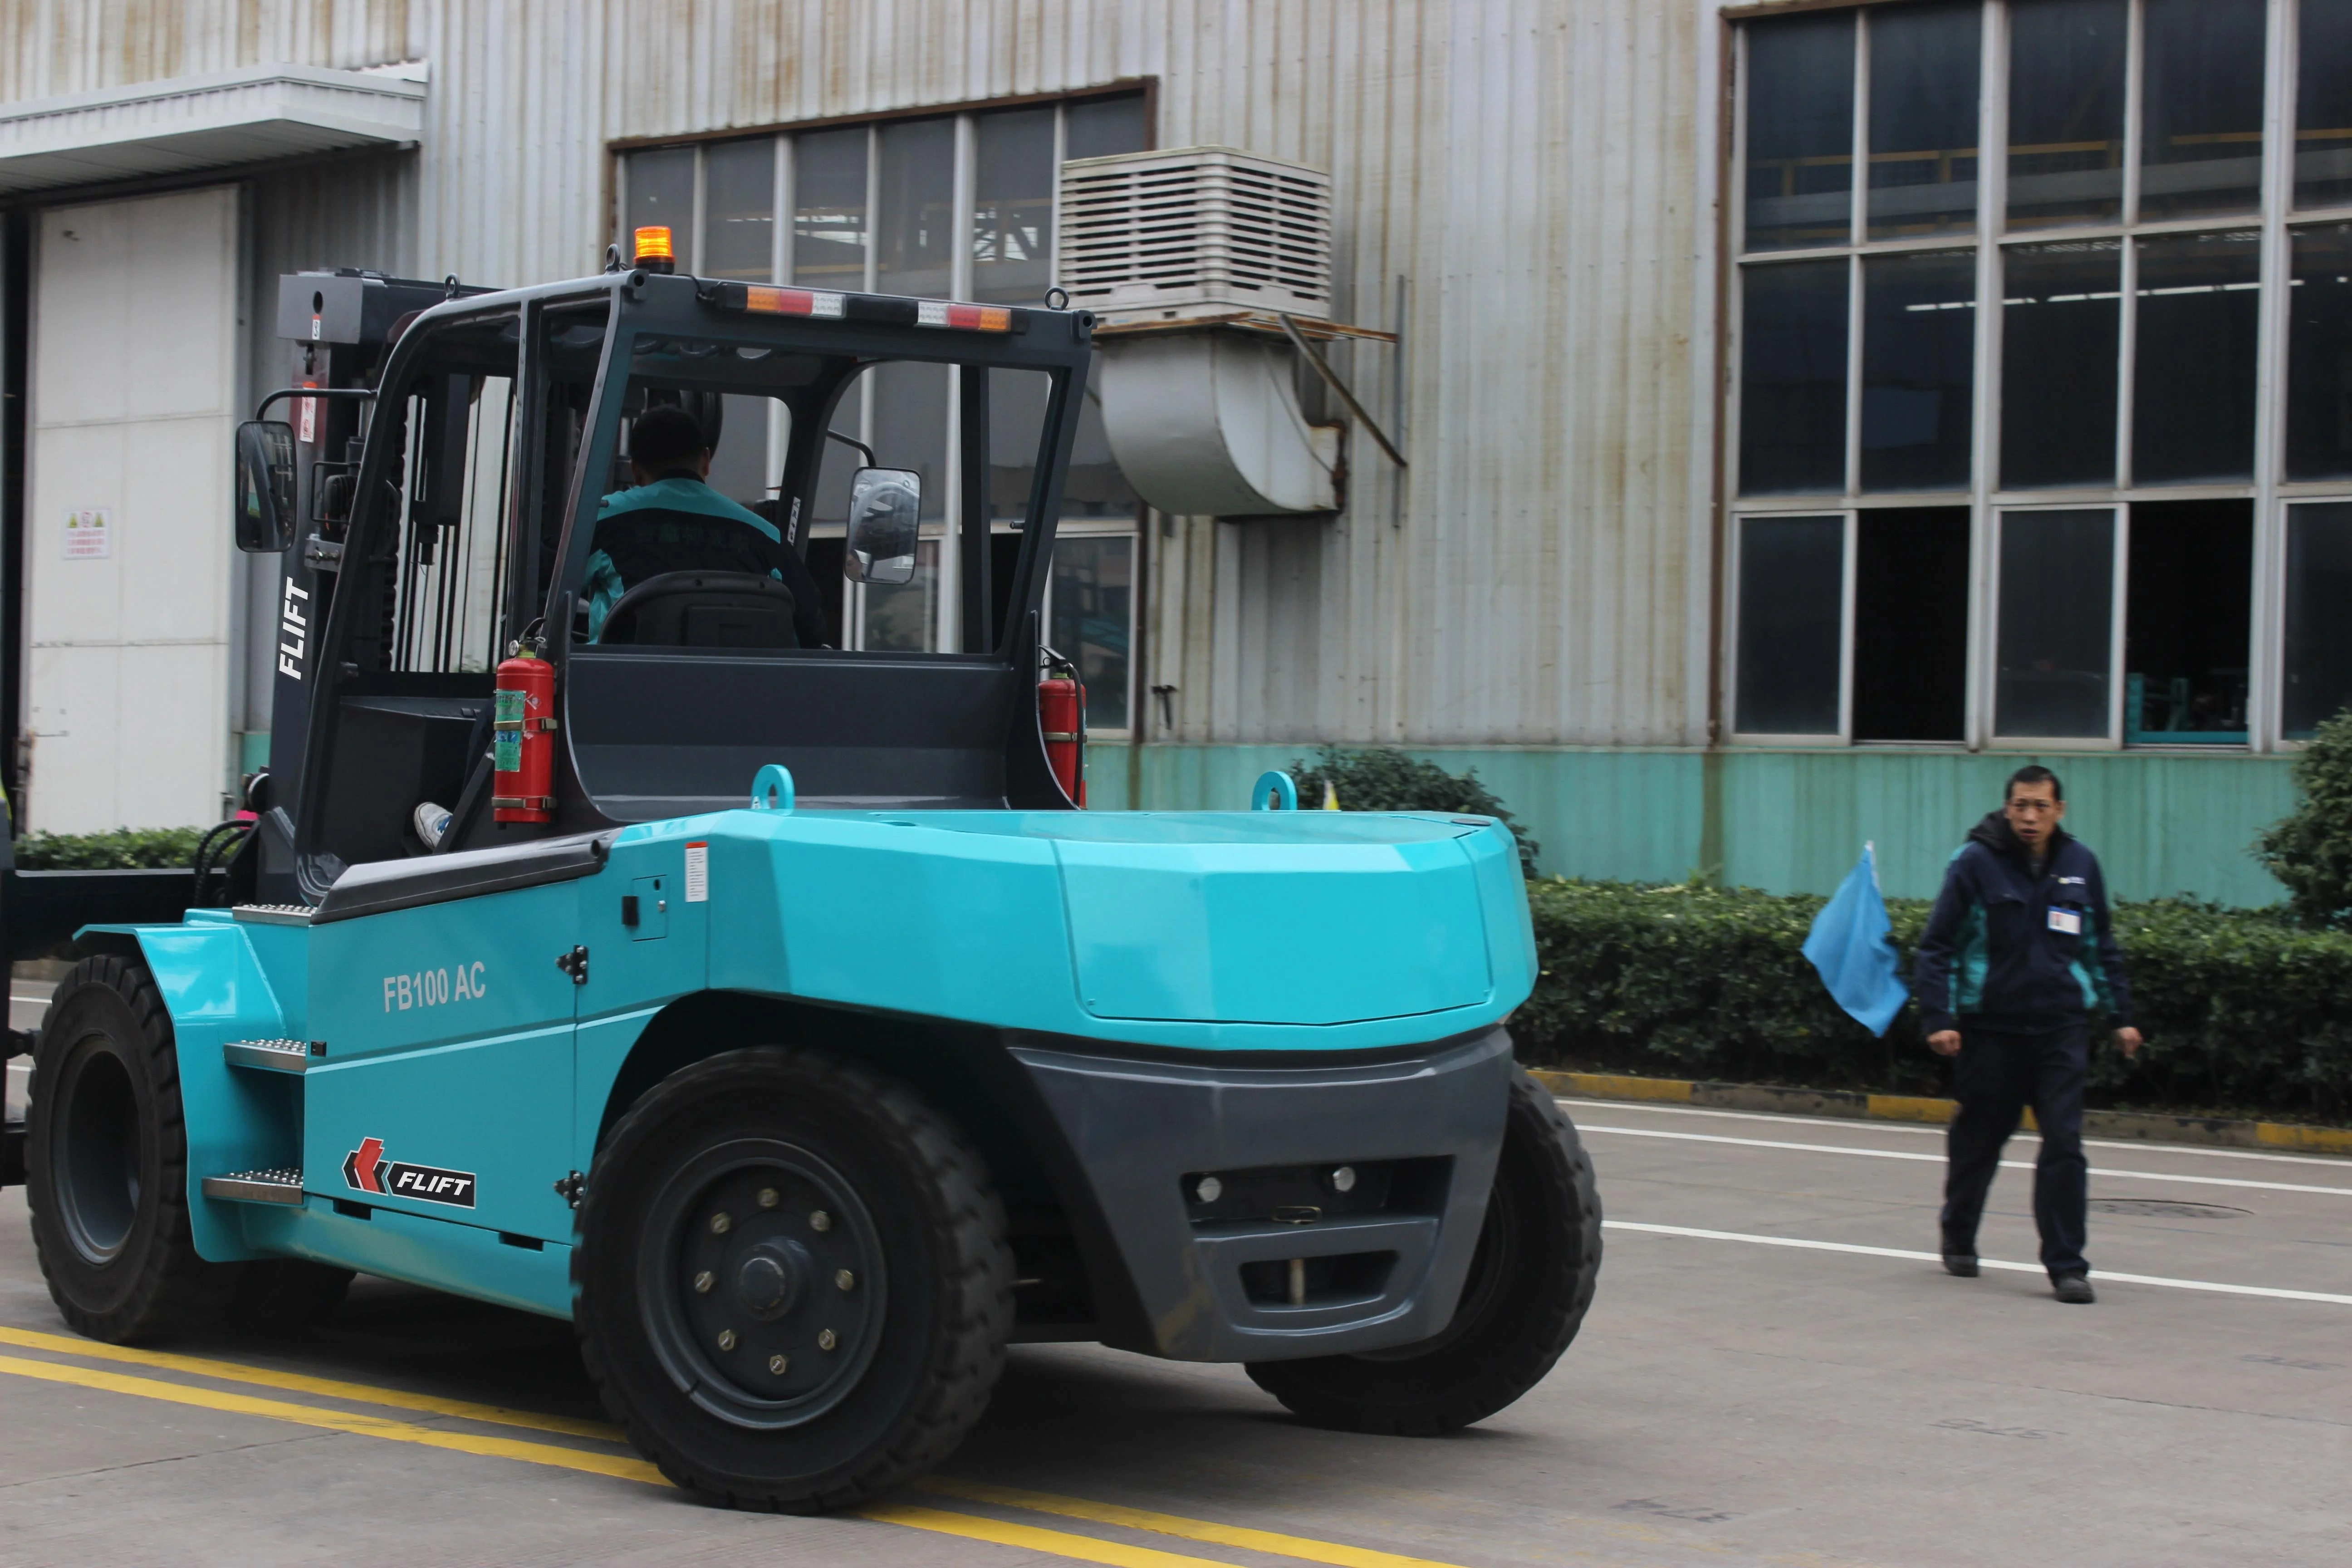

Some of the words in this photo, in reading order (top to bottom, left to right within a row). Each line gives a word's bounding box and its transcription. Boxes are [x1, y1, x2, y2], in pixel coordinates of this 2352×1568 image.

[279, 576, 309, 681] FLIFT
[383, 968, 449, 1013] FB100
[454, 961, 486, 1001] AC
[397, 1171, 472, 1196] FLIFT
